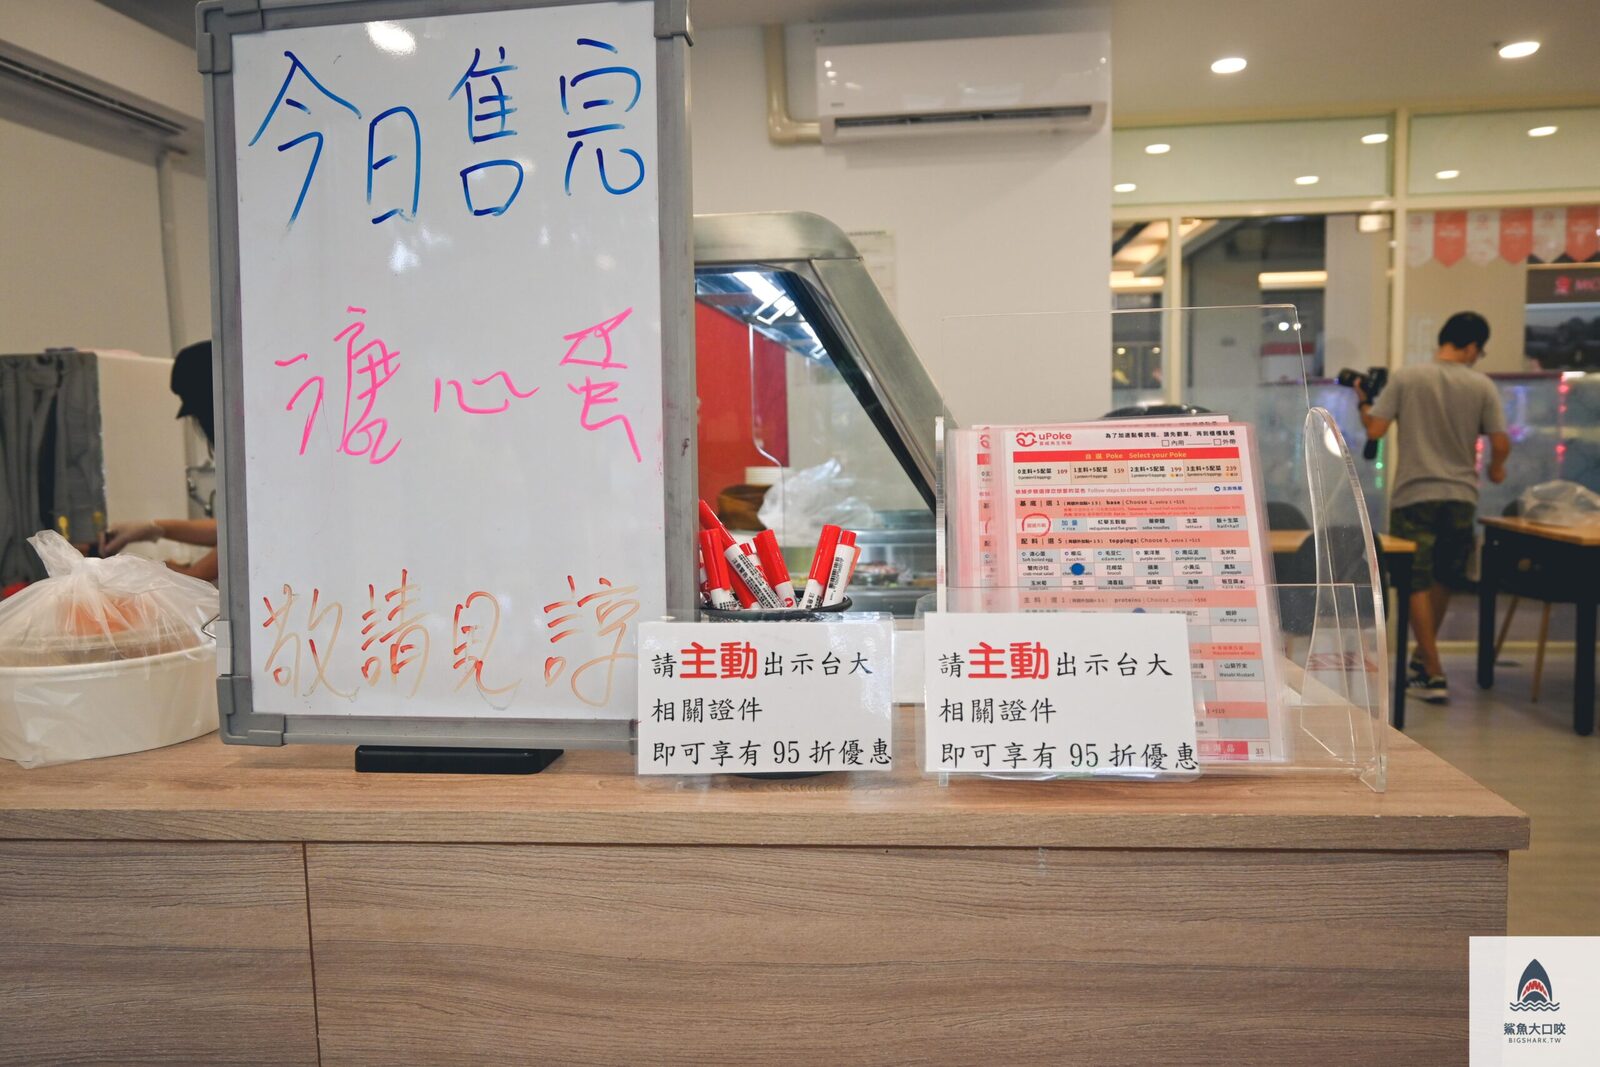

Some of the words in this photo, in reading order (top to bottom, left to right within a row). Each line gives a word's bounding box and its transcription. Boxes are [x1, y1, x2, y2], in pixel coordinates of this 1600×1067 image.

[247, 38, 645, 231] 今日售完
[1038, 432, 1072, 440] uPoke
[651, 642, 872, 679] 請主動出示台大
[938, 642, 1173, 680] 請主動出示台大
[651, 697, 763, 723] 相關證件
[938, 698, 1057, 724] 相關證件
[653, 740, 762, 766] 即可享有
[773, 740, 800, 764] 95
[809, 738, 892, 766] 折優惠
[941, 742, 1057, 769] 即可享有
[1070, 743, 1099, 768] 95
[1108, 742, 1198, 770] 折優惠
